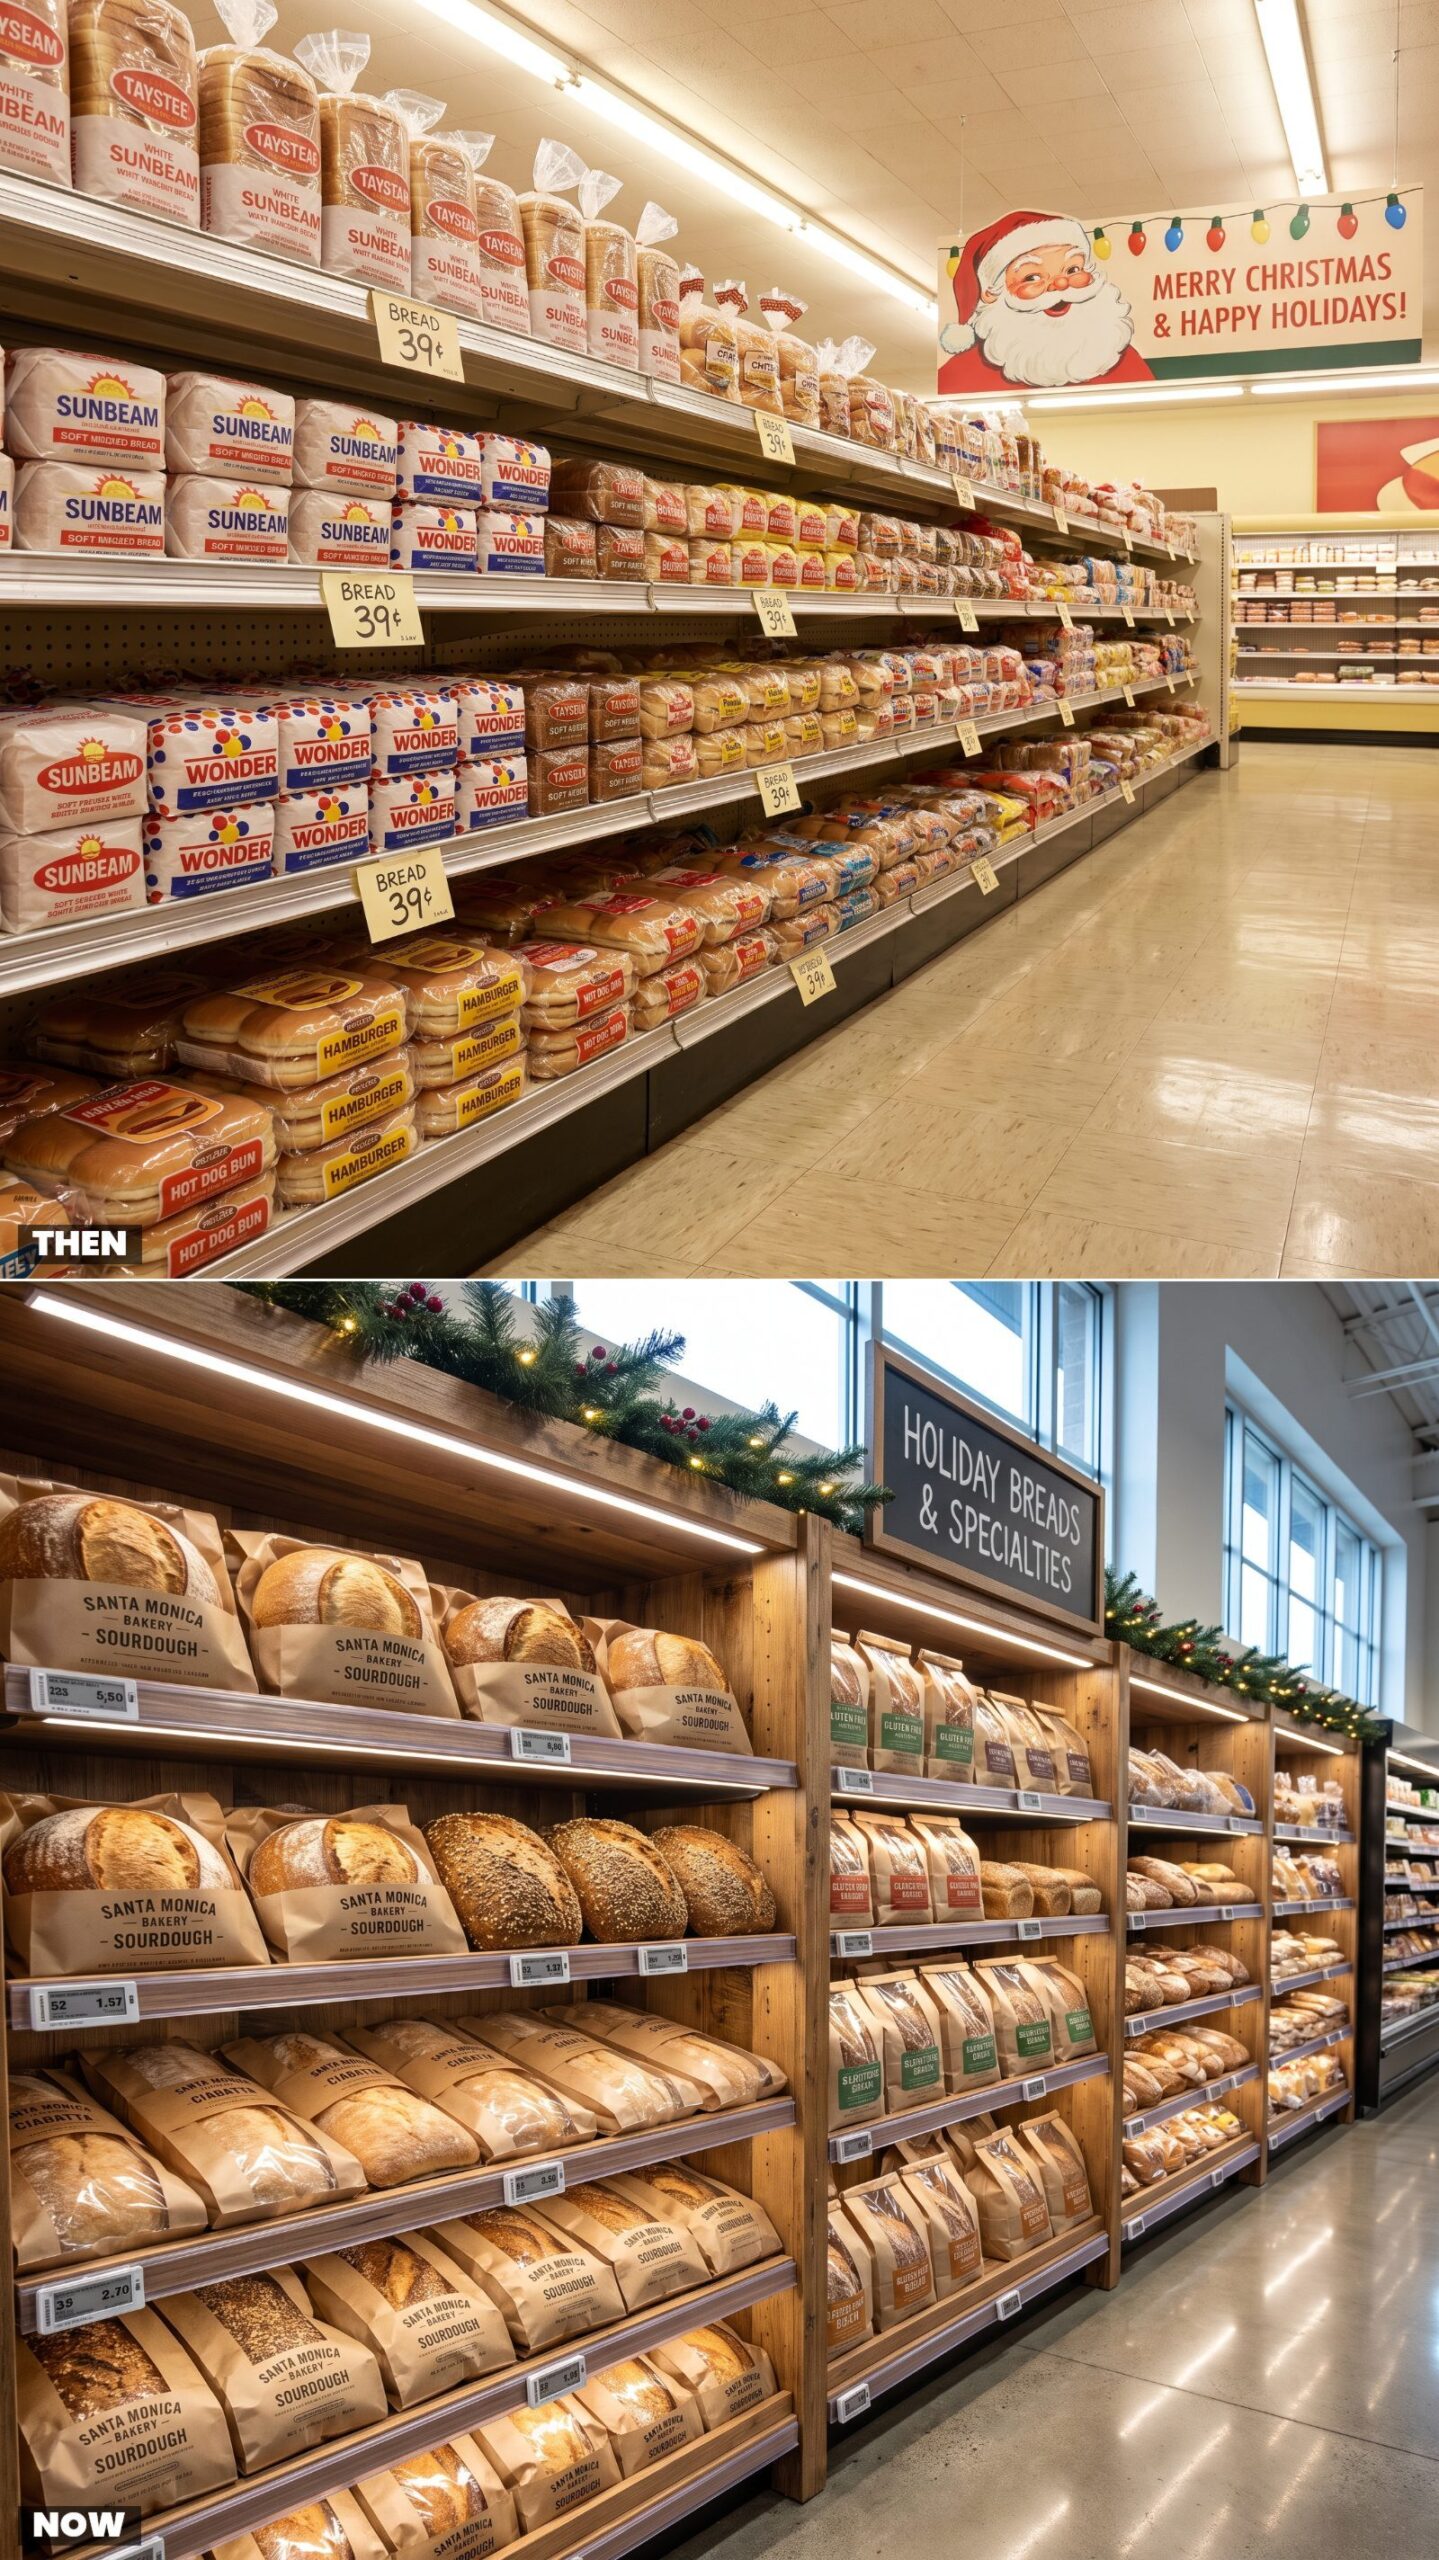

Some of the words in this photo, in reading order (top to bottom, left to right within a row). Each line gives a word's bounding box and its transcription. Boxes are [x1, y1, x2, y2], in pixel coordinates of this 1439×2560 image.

[123, 75, 188, 119] TAYSTEE
[144, 142, 174, 161] WHITE
[110, 143, 198, 191] SUNBEAM
[272, 187, 300, 204] WHITE
[241, 190, 320, 229] SUNBEAM
[375, 225, 398, 241] WHITE
[348, 228, 411, 263] SUNBEAM
[1152, 267, 1237, 301] MERRY
[1245, 252, 1393, 294] CHRISTMAS
[389, 303, 441, 332] BREAD
[1153, 314, 1171, 339] &
[1180, 304, 1262, 337] HAPPY
[1272, 291, 1407, 330] HOLIDAYS!
[397, 329, 444, 367] 39¢
[56, 394, 159, 429] SUNBEAM
[60, 431, 89, 442] SOFT
[130, 439, 157, 450] BREAD
[212, 415, 292, 446] SUNBEAM
[215, 447, 240, 457] SOFT
[330, 435, 396, 465] SUNBEAM
[330, 465, 351, 475] SOFT
[419, 456, 480, 481] WONDER
[498, 464, 550, 486] WONDER
[65, 498, 162, 525] SUNBEAM
[208, 509, 287, 534] SUNBEAM
[68, 533, 95, 543] SOFT
[136, 536, 160, 547] BREAD
[321, 522, 389, 544] SUNBEAM
[417, 531, 476, 552] WONDER
[211, 542, 234, 551] SOFT
[493, 537, 544, 555] WONDER
[341, 582, 395, 601] BREAD
[354, 605, 402, 638] 39¢
[766, 610, 786, 631] 39¢
[294, 740, 370, 765] WONDER
[393, 730, 457, 752] WONDER
[48, 758, 138, 788] SUNBEAM
[186, 754, 277, 784] WONDER
[764, 773, 788, 789] BREAD
[57, 800, 77, 810] SOFT
[110, 792, 132, 803] WHITE
[475, 785, 528, 808] WONDER
[770, 786, 790, 808] 39¢
[390, 802, 454, 829] WONDER
[291, 818, 367, 849] WONDER
[180, 839, 272, 872] WONDER
[44, 854, 133, 887] SUNBEAM
[376, 863, 426, 893] BREAD
[54, 898, 72, 909] SOFT
[107, 888, 128, 898] WHITE
[388, 886, 433, 926] 39¢
[463, 978, 519, 1012] HAMBURGER
[323, 1018, 397, 1060] HAMBURGER
[458, 1028, 516, 1064] HAMBURGER
[329, 1079, 403, 1124] HAMBURGER
[462, 1075, 520, 1114] HAMBURGER
[330, 1136, 405, 1183] HAMBURGER
[171, 1177, 199, 1201] HOT
[201, 1164, 228, 1188] DOG
[230, 1151, 256, 1175] BUN
[179, 1240, 208, 1264] HOT
[209, 1223, 237, 1248] DOG
[237, 1208, 262, 1234] BUN
[904, 1405, 1000, 1503] HOLIDAY
[1010, 1467, 1080, 1546] BREADS
[919, 1483, 938, 1534] &
[949, 1499, 1072, 1593] SPECIALTIES
[83, 1595, 139, 1611] SANTA
[145, 1599, 203, 1628] MONICA
[123, 1615, 173, 1632] BAKERY
[96, 1629, 198, 1657] SOURDOUGH
[335, 1638, 378, 1652] SANTA
[383, 1640, 425, 1665] MONICA
[366, 1655, 402, 1668] BAKERY
[344, 1666, 420, 1689] SOURDOUGH
[524, 1672, 559, 1684] SANTA
[562, 1674, 595, 1694] MONICA
[549, 1686, 578, 1697] BAKERY
[675, 1693, 703, 1705] SANTA
[705, 1694, 732, 1712] MONICA
[532, 1696, 593, 1715] SOURDOUGH
[682, 1715, 730, 1732] SOURDOUGH
[884, 1720, 910, 1732] GLUTEN
[101, 1898, 155, 1919] SANTA
[161, 1898, 216, 1916] MONICA
[340, 1891, 382, 1910] SANTA
[386, 1891, 427, 1908] MONICA
[371, 1906, 405, 1916] BAKERY
[142, 1916, 188, 1927] BAKERY
[350, 1919, 424, 1935] SOURDOUGH
[113, 1930, 213, 1949] SOURDOUGH
[51, 2000, 67, 2011] 52
[96, 1996, 123, 2008] 1.57
[175, 2078, 210, 2095] SANTA
[326, 2068, 383, 2085] CIABATTA
[191, 2086, 257, 2105] CIABATTA
[14, 2113, 94, 2131] CIABATTA
[528, 2263, 554, 2282] SANTA
[553, 2258, 586, 2269] MONICA
[549, 2267, 574, 2281] BAKERY
[102, 2284, 129, 2301] 2.70
[543, 2274, 596, 2301] SOURDOUGH
[402, 2306, 433, 2329] SANTA
[433, 2299, 471, 2312] MONICA
[427, 2311, 456, 2327] BAKERY
[418, 2318, 480, 2349] SOURDOUGH
[259, 2356, 296, 2384] SANTA
[297, 2347, 341, 2365] MONICA
[288, 2361, 324, 2381] BAKERY
[275, 2369, 350, 2407] SOURDOUGH
[79, 2416, 125, 2446] SANTA
[127, 2402, 182, 2424] MONICA
[114, 2419, 158, 2442] BAKERY
[94, 2428, 188, 2475] SOURDOUGH
[551, 2472, 573, 2493] SANTA
[574, 2460, 599, 2476] MONICA
[555, 2478, 600, 2510] SOURDOUGH
[433, 2531, 462, 2557] SANTA
[463, 2518, 493, 2536] MONICA
[454, 2533, 478, 2553] BAKERY
